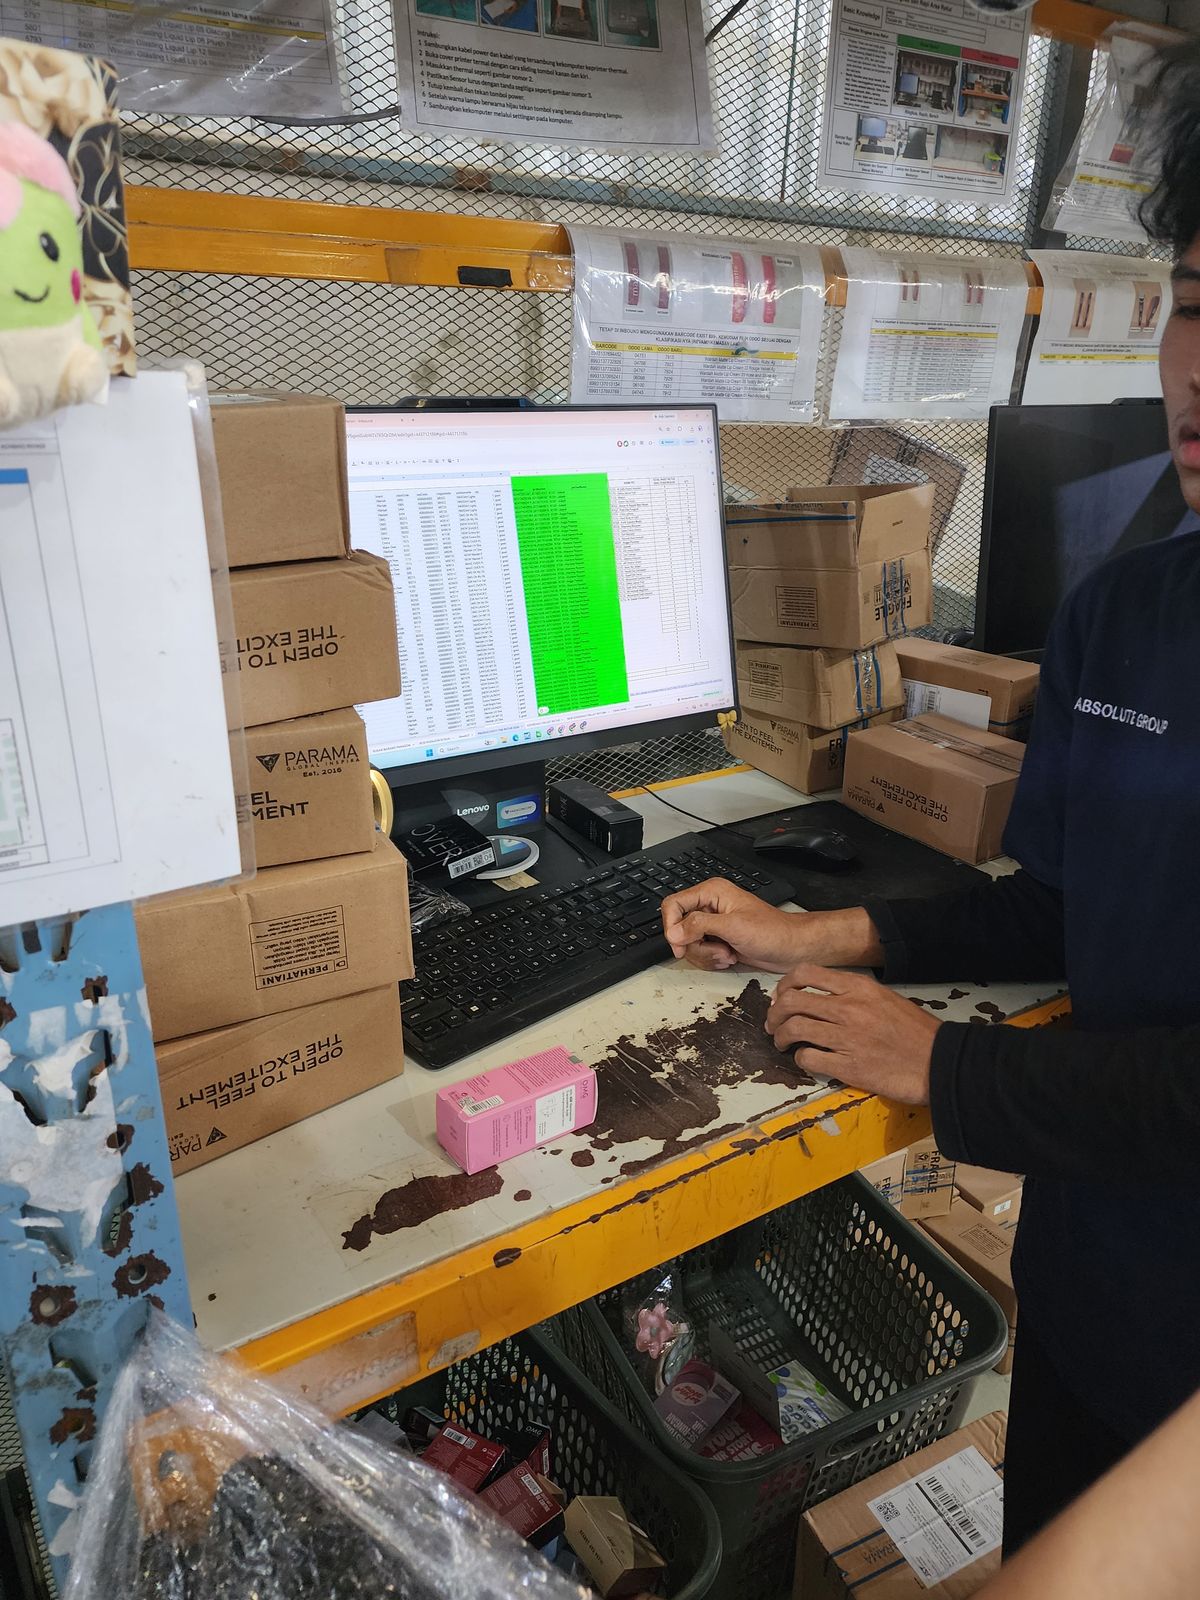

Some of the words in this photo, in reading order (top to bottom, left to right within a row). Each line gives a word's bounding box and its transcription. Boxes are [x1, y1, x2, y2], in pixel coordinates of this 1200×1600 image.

[843, 5, 856, 15] Basic
[856, 9, 881, 20] Knowledge
[875, 596, 912, 620] FRAGLE
[298, 625, 337, 643] THE
[248, 651, 276, 668] TO
[284, 642, 338, 664] OPEN
[1074, 697, 1136, 725] ABSOLUTE
[1136, 714, 1168, 734] GROUP
[732, 726, 743, 736] THE
[744, 731, 783, 756] EXCITEMENT
[750, 726, 758, 735] TO
[760, 730, 775, 744] FEEL
[777, 724, 800, 740] PARAMA
[285, 744, 358, 766] PARAMA
[287, 762, 320, 771] GLOBAL
[326, 758, 360, 766] INSPIRA
[322, 767, 342, 776] 2016
[848, 790, 875, 809] PARAMA
[871, 776, 926, 805] EXCITEMENT
[882, 788, 903, 804] FEEL
[457, 804, 490, 816] Lenovo
[906, 799, 918, 811] TO
[921, 804, 948, 822] OPEN
[929, 800, 948, 814] THE
[263, 964, 329, 986] PERHATIAN!
[306, 1033, 342, 1053] THE
[293, 1046, 343, 1076] OPEN
[176, 1050, 300, 1110] EXCITEMENT
[262, 1070, 288, 1088] TO
[207, 1082, 255, 1110] FEEL
[927, 1150, 941, 1194] FRAGILE
[526, 1426, 542, 1436] OMG
